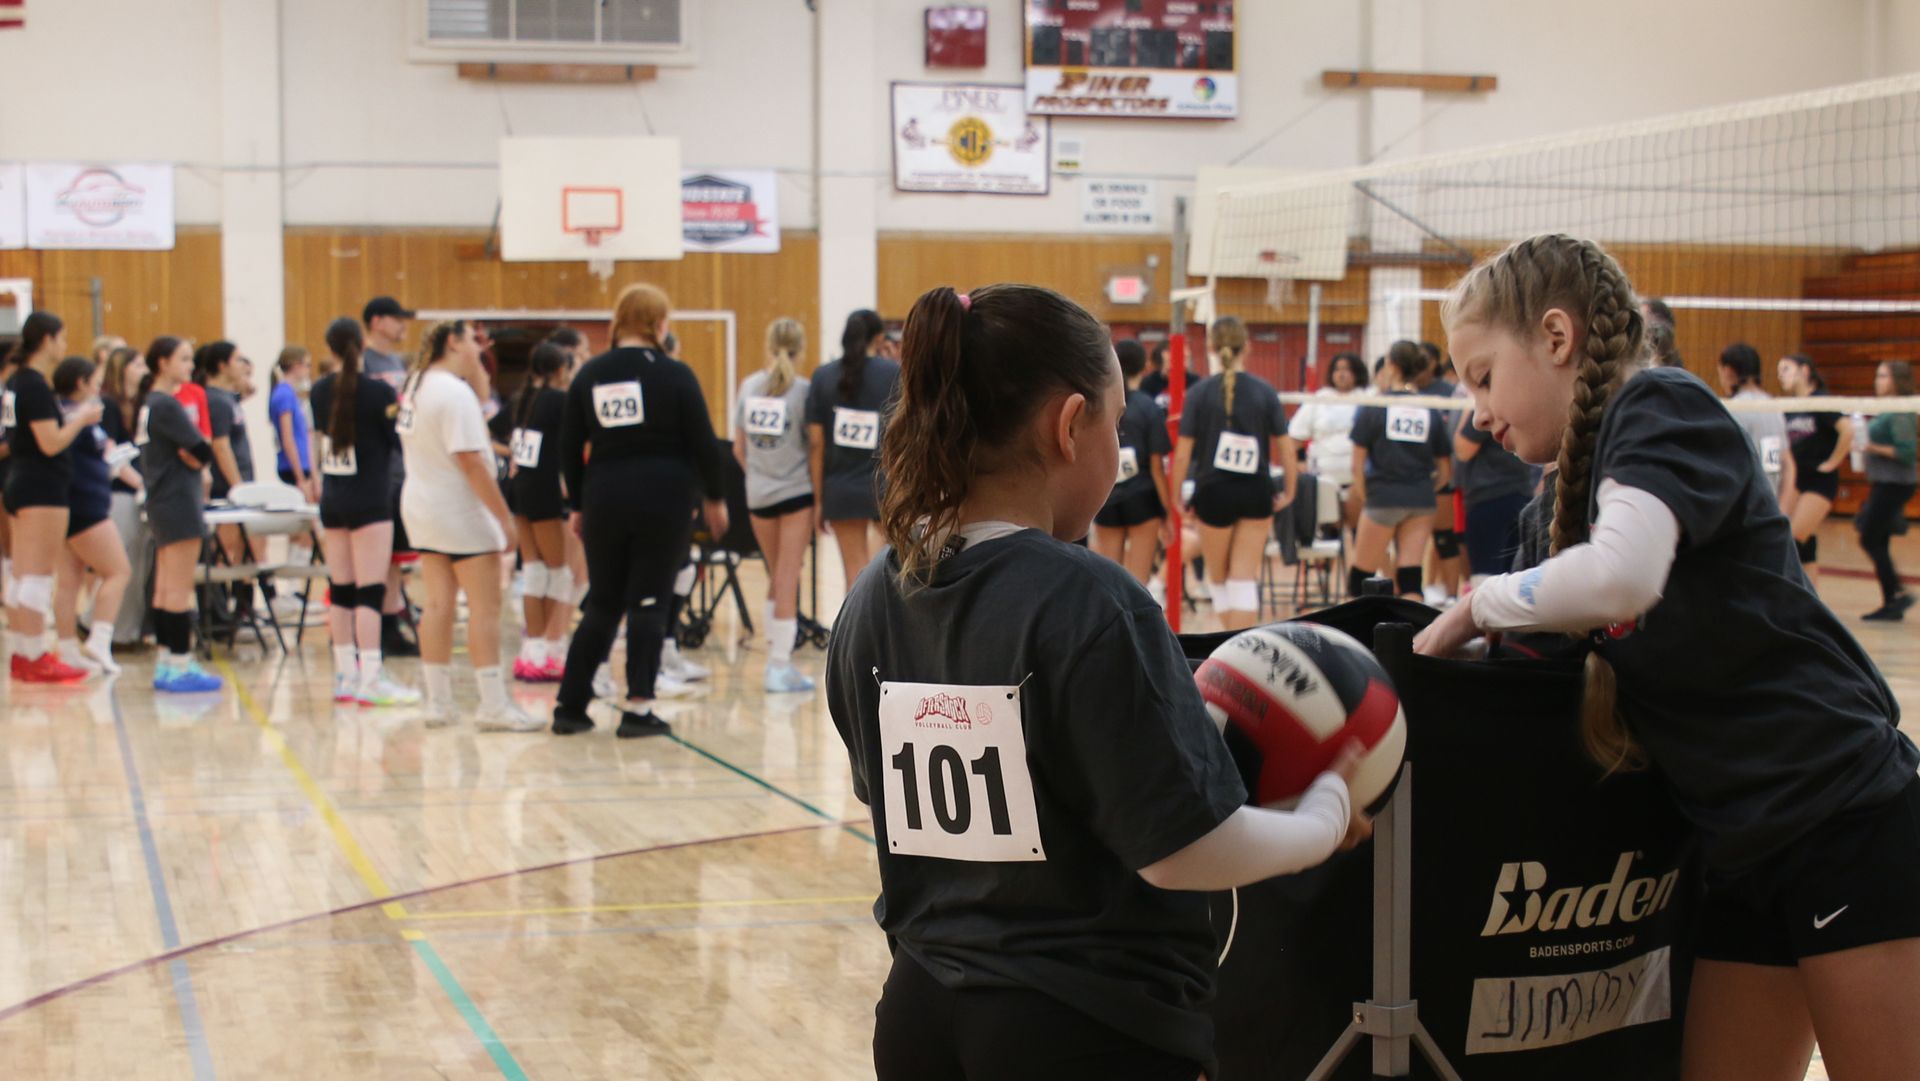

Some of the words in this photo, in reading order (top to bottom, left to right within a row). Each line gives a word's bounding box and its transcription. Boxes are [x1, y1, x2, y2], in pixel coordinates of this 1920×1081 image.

[601, 397, 638, 419] 429
[749, 409, 780, 429] 422
[1391, 416, 1425, 436] 426
[839, 421, 873, 442] 427
[1219, 447, 1255, 466] 417
[915, 722, 952, 730] VOLLEYBALL
[955, 723, 972, 731] CLUB
[891, 742, 1012, 835] 101
[1480, 851, 1680, 936] Baden
[1529, 935, 1635, 958] BADENSPORTS.COM
